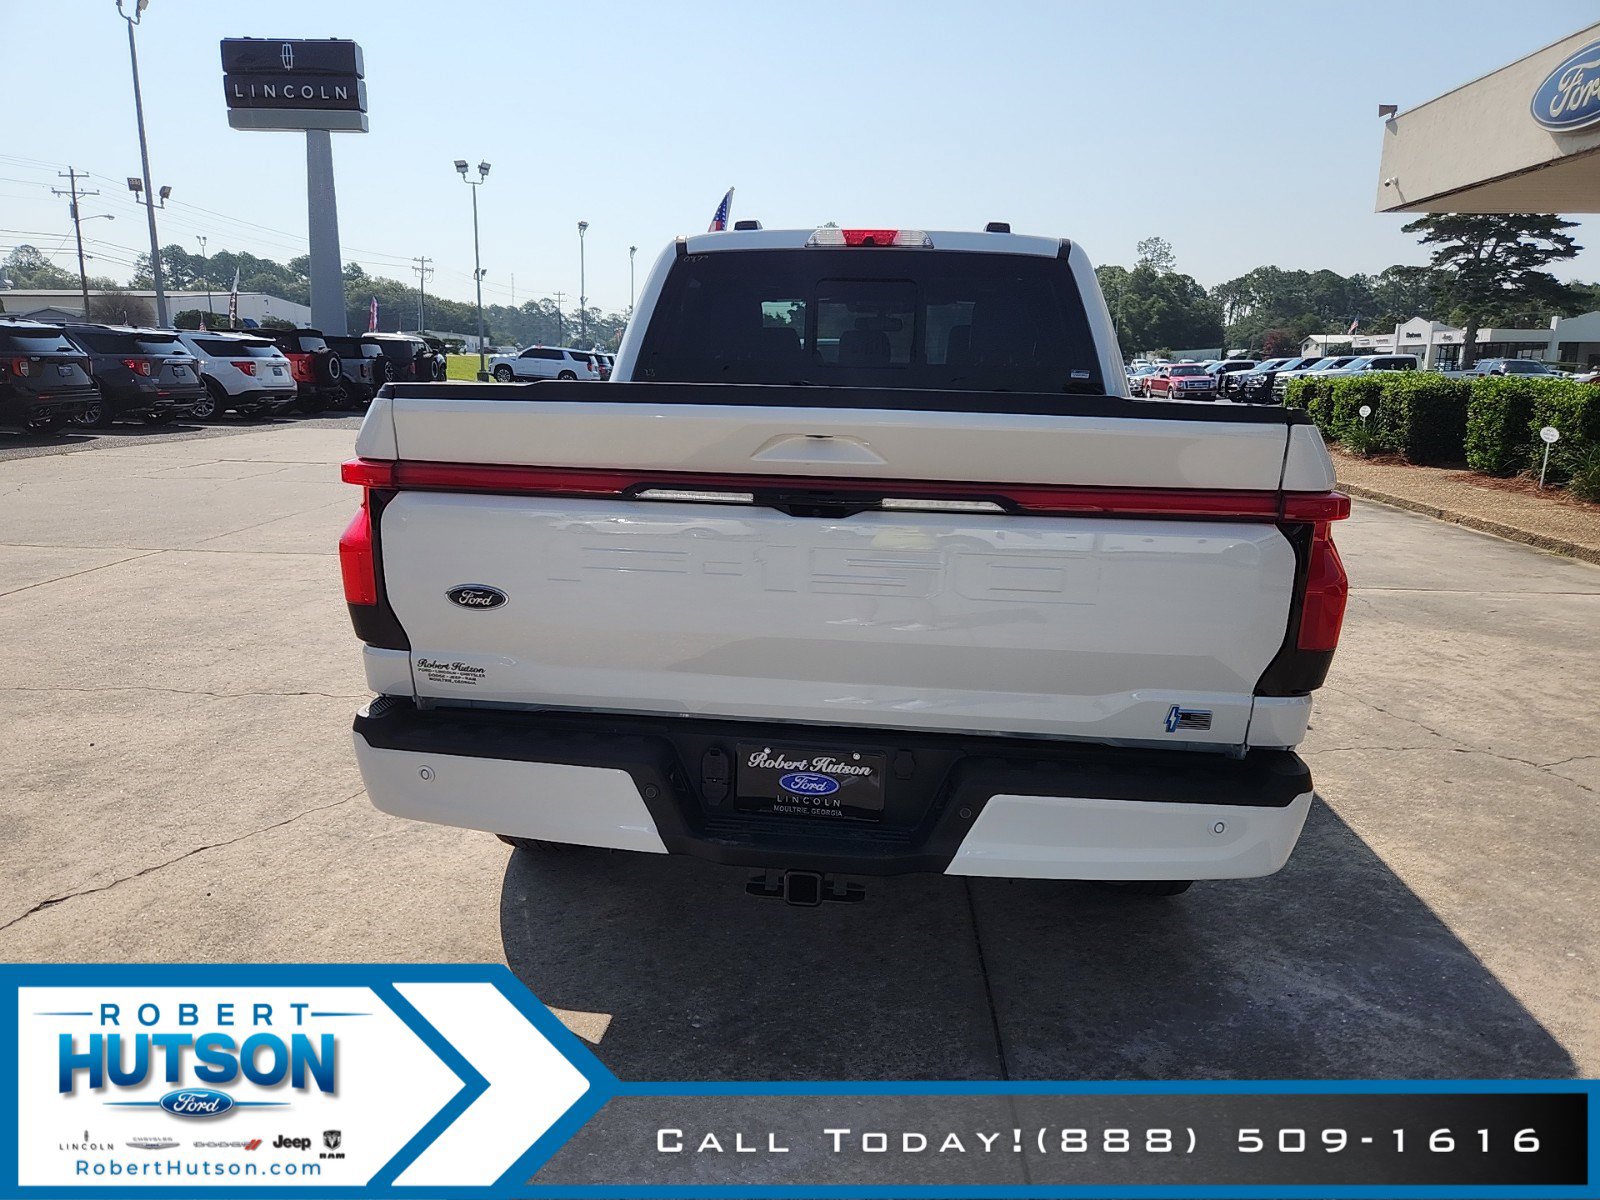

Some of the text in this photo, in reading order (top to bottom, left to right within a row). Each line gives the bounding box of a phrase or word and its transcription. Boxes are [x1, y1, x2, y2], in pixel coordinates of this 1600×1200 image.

[234, 84, 348, 99] LINCOLN
[1549, 59, 1600, 117] For
[459, 589, 493, 606] Ford
[417, 658, 486, 674] Robert Hutson
[748, 752, 873, 777] Robert Hutson
[790, 775, 827, 792] Ford
[776, 794, 841, 808] LINCOLN
[773, 804, 843, 817] MOULTRIE, GEORGIA
